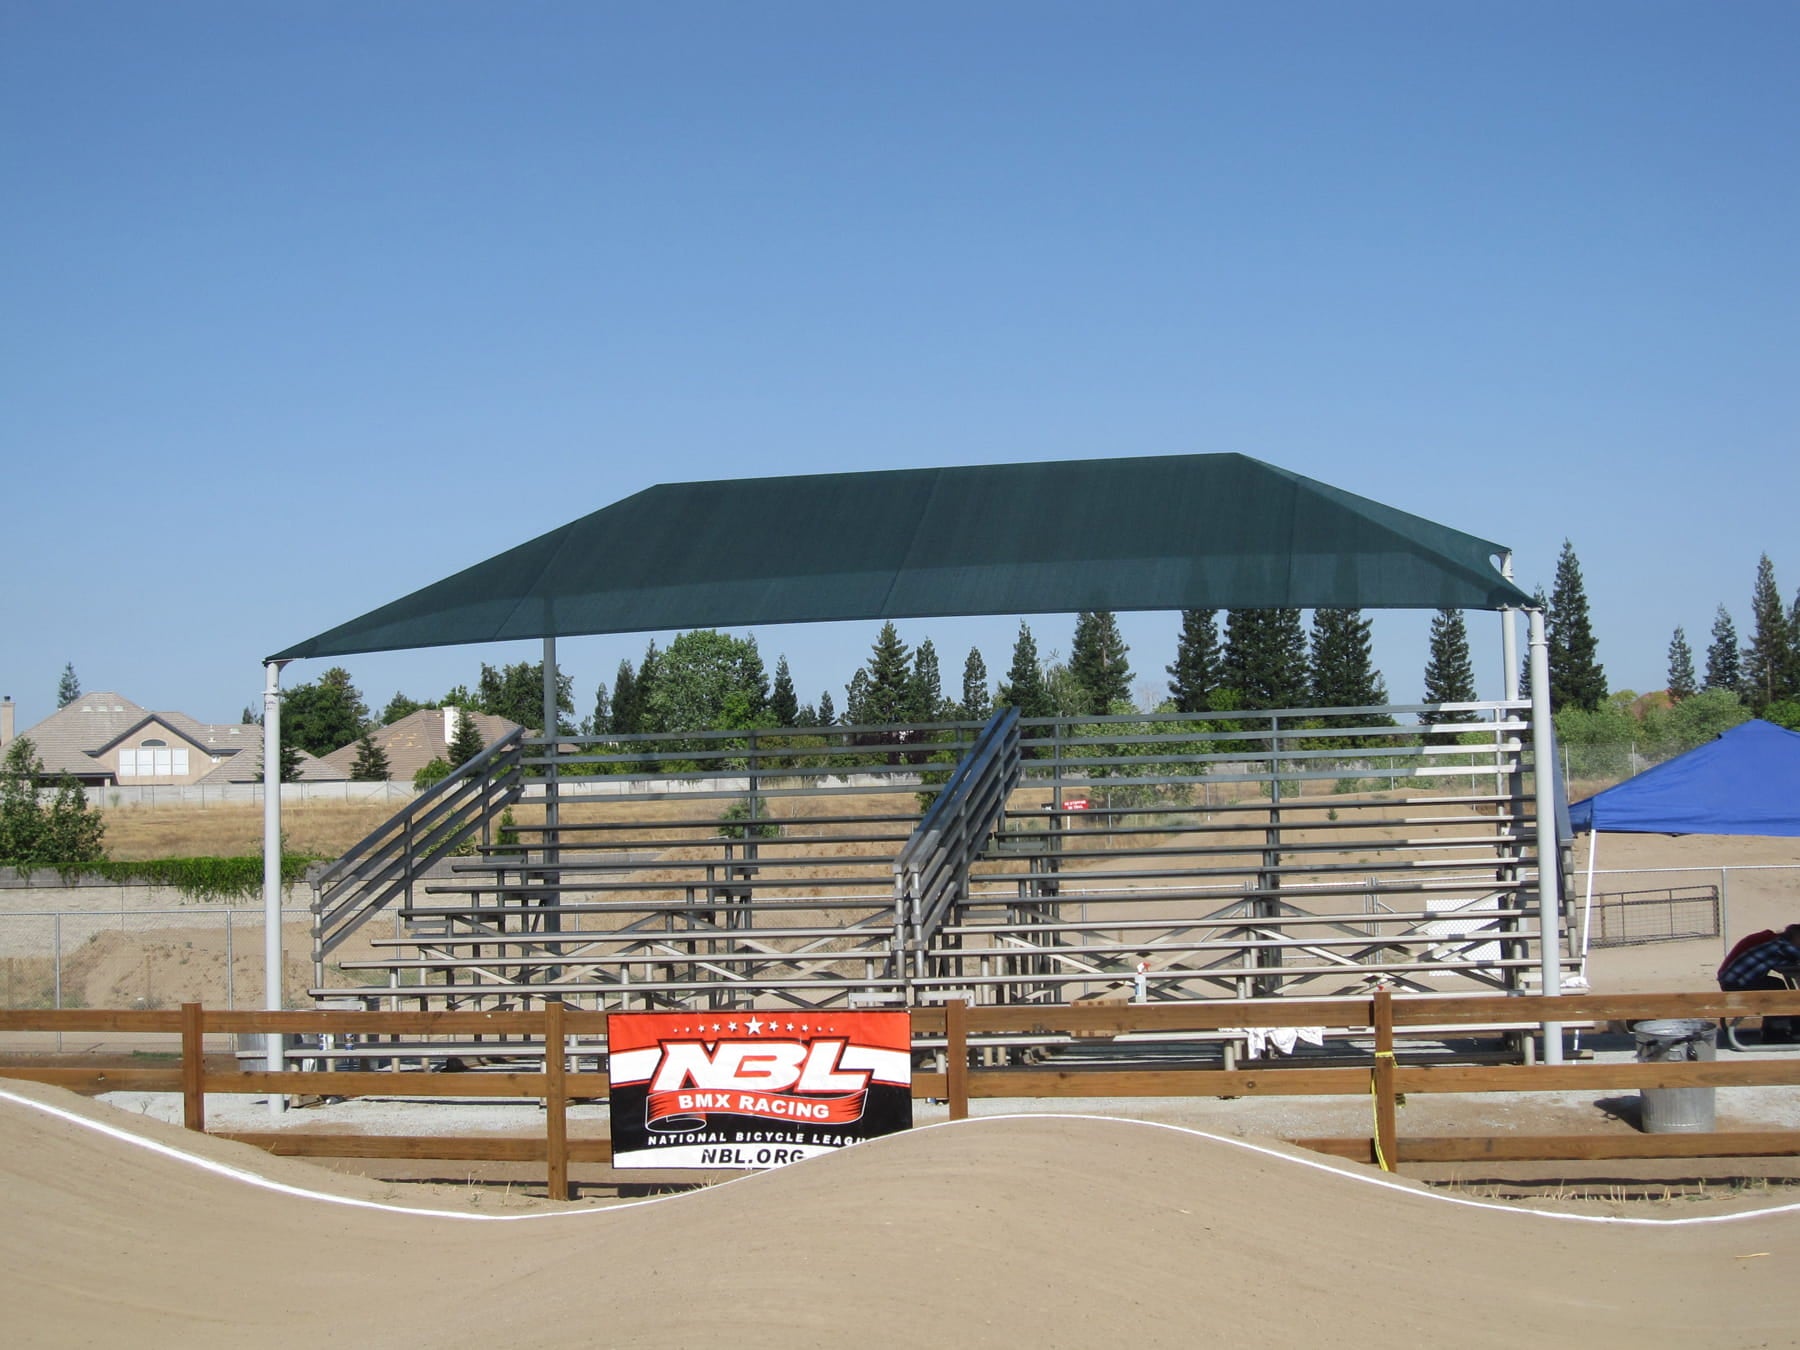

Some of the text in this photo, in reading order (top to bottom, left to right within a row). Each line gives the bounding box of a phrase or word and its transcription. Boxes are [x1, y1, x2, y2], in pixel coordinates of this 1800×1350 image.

[650, 1039, 871, 1092] NBL
[678, 1093, 830, 1119] BMX RACING
[648, 1132, 727, 1146] NATIONAL
[735, 1132, 805, 1143] BICYCLE
[701, 1148, 804, 1164] NBL.ORG
